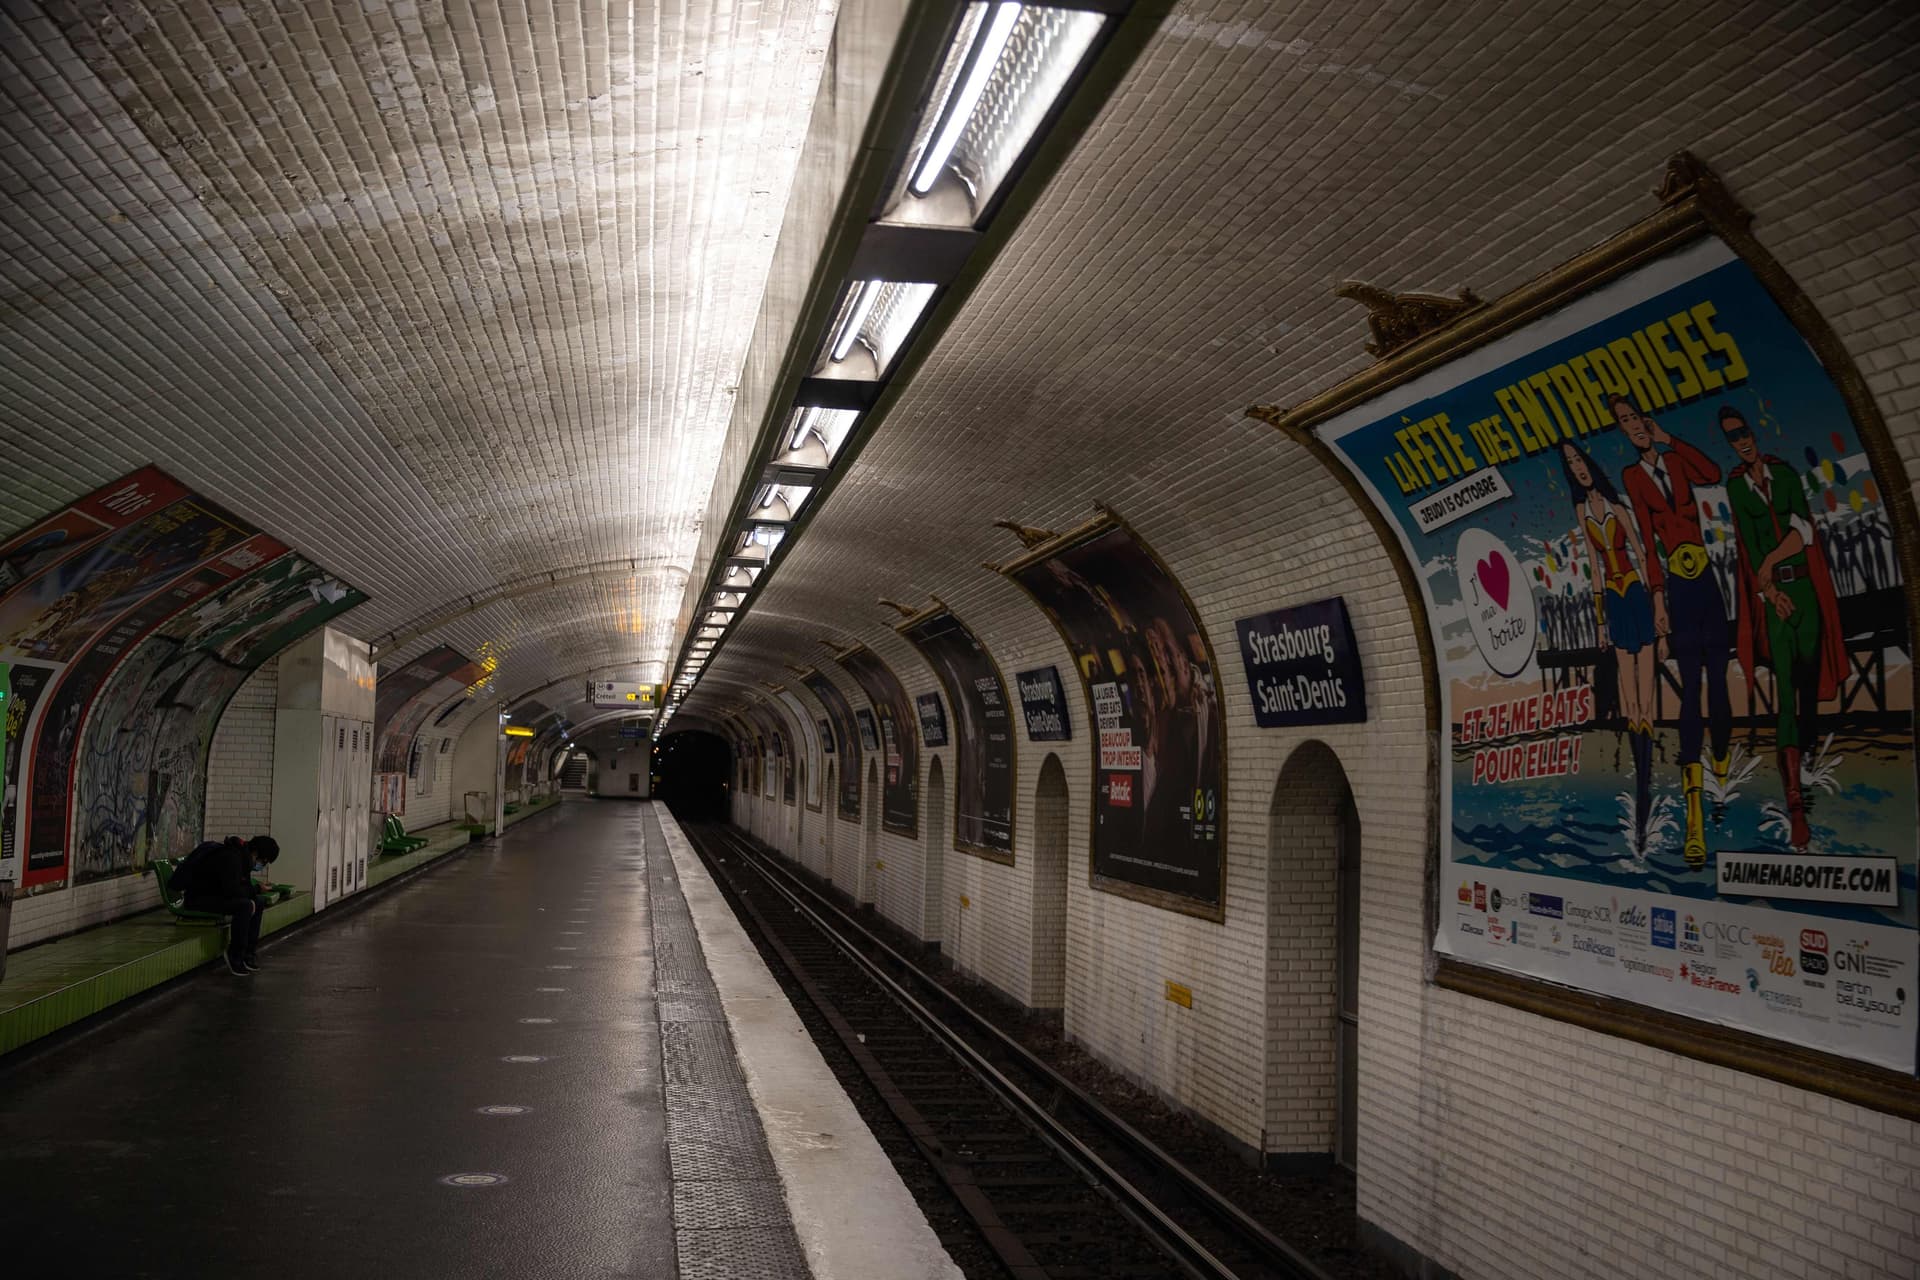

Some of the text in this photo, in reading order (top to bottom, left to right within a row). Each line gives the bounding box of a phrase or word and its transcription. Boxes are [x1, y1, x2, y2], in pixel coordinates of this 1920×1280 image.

[1384, 300, 1749, 494] LA FÊTE DES ENTREPRISES
[1420, 475, 1498, 524] JEUDI 15 OCTOBRE
[1248, 623, 1335, 664] Strasbourg
[1020, 678, 1055, 705] Strasbourg
[1257, 668, 1346, 713] Saint-Denis
[1109, 701, 1121, 713] EATS
[1463, 687, 1590, 742] ET JE ME BATS
[1101, 733, 1130, 747] BEAUCOUP
[1102, 751, 1140, 766] TROP INTENSE
[1473, 746, 1523, 785] POUR
[1526, 739, 1570, 778] ELLE
[1722, 862, 1891, 892] JAIMEMABOITE.COM
[1702, 921, 1751, 946] CNCC
[1801, 933, 1826, 948] SUD
[1801, 956, 1826, 970] RADIO
[1834, 951, 1866, 974] GNI
[1836, 980, 1872, 996] martin
[1836, 993, 1901, 1016] belaysoud
